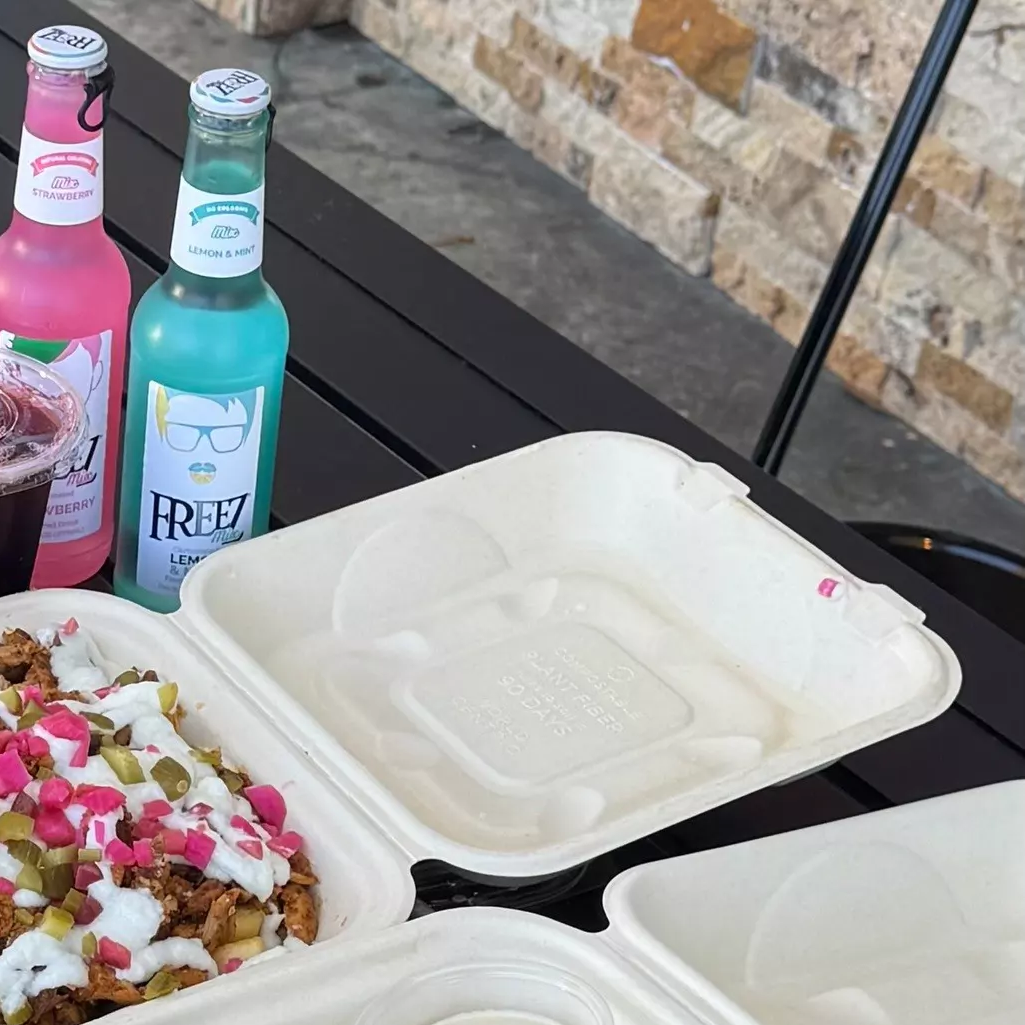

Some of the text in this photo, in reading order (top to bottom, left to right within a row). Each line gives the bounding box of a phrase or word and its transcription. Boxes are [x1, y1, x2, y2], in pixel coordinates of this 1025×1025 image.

[32, 188, 94, 201] STRAWBERRY
[188, 244, 256, 259] LEMON & MINT
[149, 490, 248, 541] FREEZ
[170, 553, 207, 566] LEM
